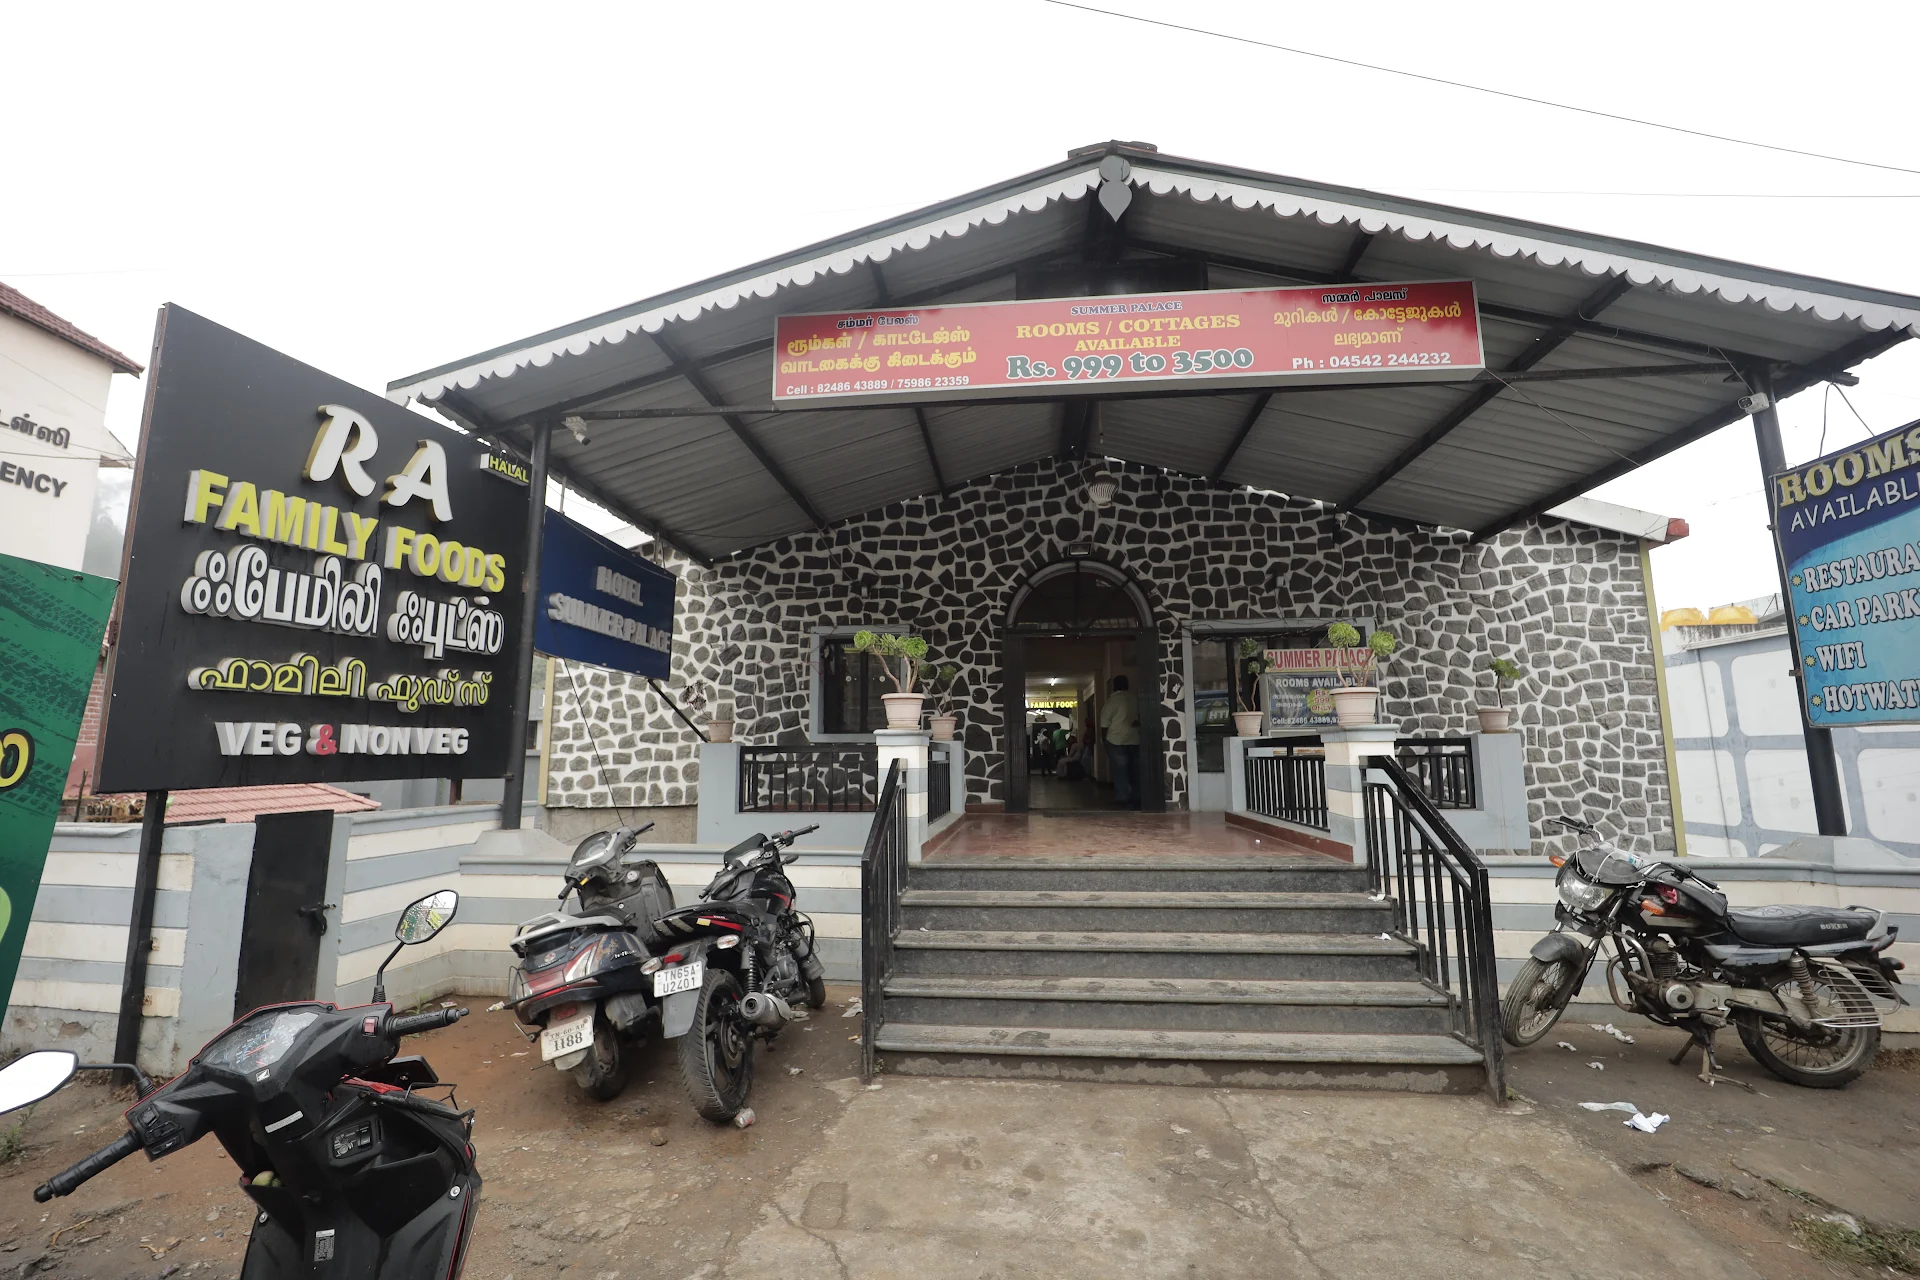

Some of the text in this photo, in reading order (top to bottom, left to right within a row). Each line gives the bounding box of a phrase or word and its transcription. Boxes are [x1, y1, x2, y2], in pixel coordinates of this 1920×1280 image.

[837, 313, 919, 329] சம்மர் பேலஸ்
[1071, 301, 1183, 316] SUMMER PALACE
[1016, 321, 1100, 338] ROOMS
[1118, 314, 1241, 334] COTTAGES
[788, 332, 852, 357] ரூம்கள்
[1074, 335, 1181, 352] AVAILABLE
[781, 346, 976, 374] வாடகைக்கு கிடைக்கும்
[1007, 347, 1254, 379] Rs. 999 to 3500
[1292, 357, 1314, 369] Ph
[1329, 354, 1383, 368] 04542
[1387, 352, 1452, 366] 244232
[786, 385, 807, 395] Cell
[817, 381, 850, 393] 82486
[854, 379, 888, 391] 43889
[898, 376, 931, 388] 75986
[935, 375, 970, 387] 23359
[0, 409, 70, 449] ன்ஸி
[488, 455, 530, 483] HALAL
[1791, 472, 1920, 532] AVAILABL
[184, 469, 505, 593] FAMILY FOODS
[1803, 541, 1920, 593] RESTAURA
[596, 566, 643, 607] HOTEL
[181, 544, 505, 660] ஃபேமிலி ஃபுட்ஸ்
[1810, 586, 1920, 632] CAR PARK
[1815, 641, 1867, 672] WIFI
[188, 652, 367, 698] ഫാമിലി
[1275, 679, 1309, 688] ROOMS
[1030, 701, 1054, 709] FAMILY
[1822, 678, 1920, 712] HOTWAT
[214, 721, 301, 756] VEG
[306, 724, 338, 755] &
[663, 976, 695, 993] U2401
[664, 965, 696, 981] TN65A
[554, 1032, 583, 1051] 1188
